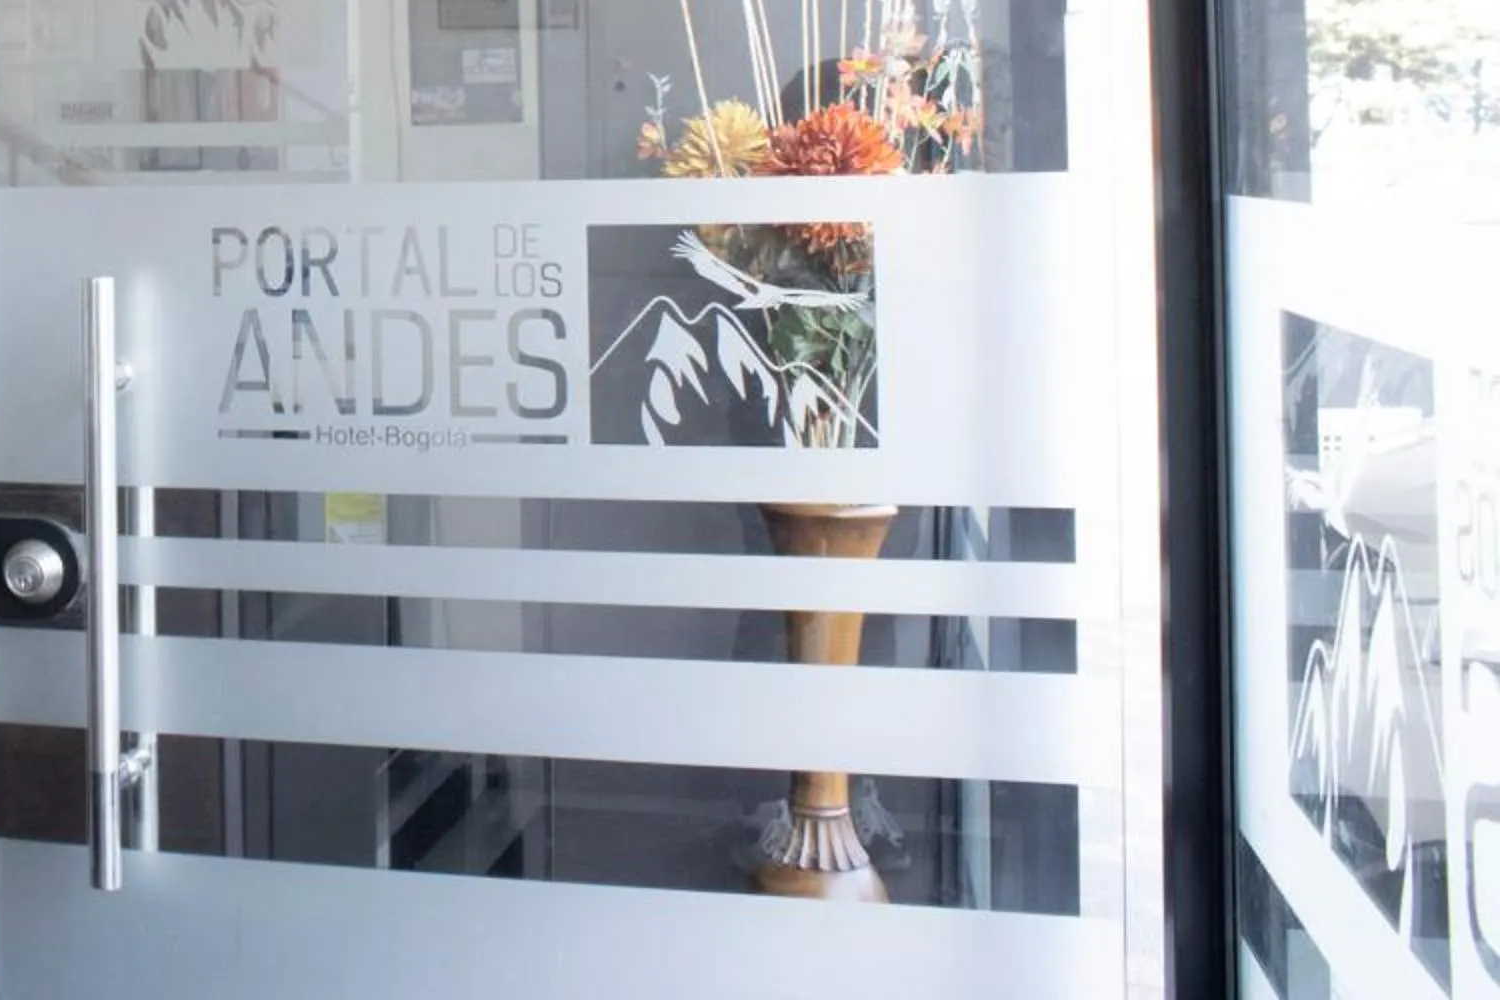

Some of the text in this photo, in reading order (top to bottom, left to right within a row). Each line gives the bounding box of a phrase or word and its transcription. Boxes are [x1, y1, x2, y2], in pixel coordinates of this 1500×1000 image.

[212, 224, 539, 297] PORTAL DE
[495, 264, 562, 298] LOS
[218, 308, 567, 418] ANDES
